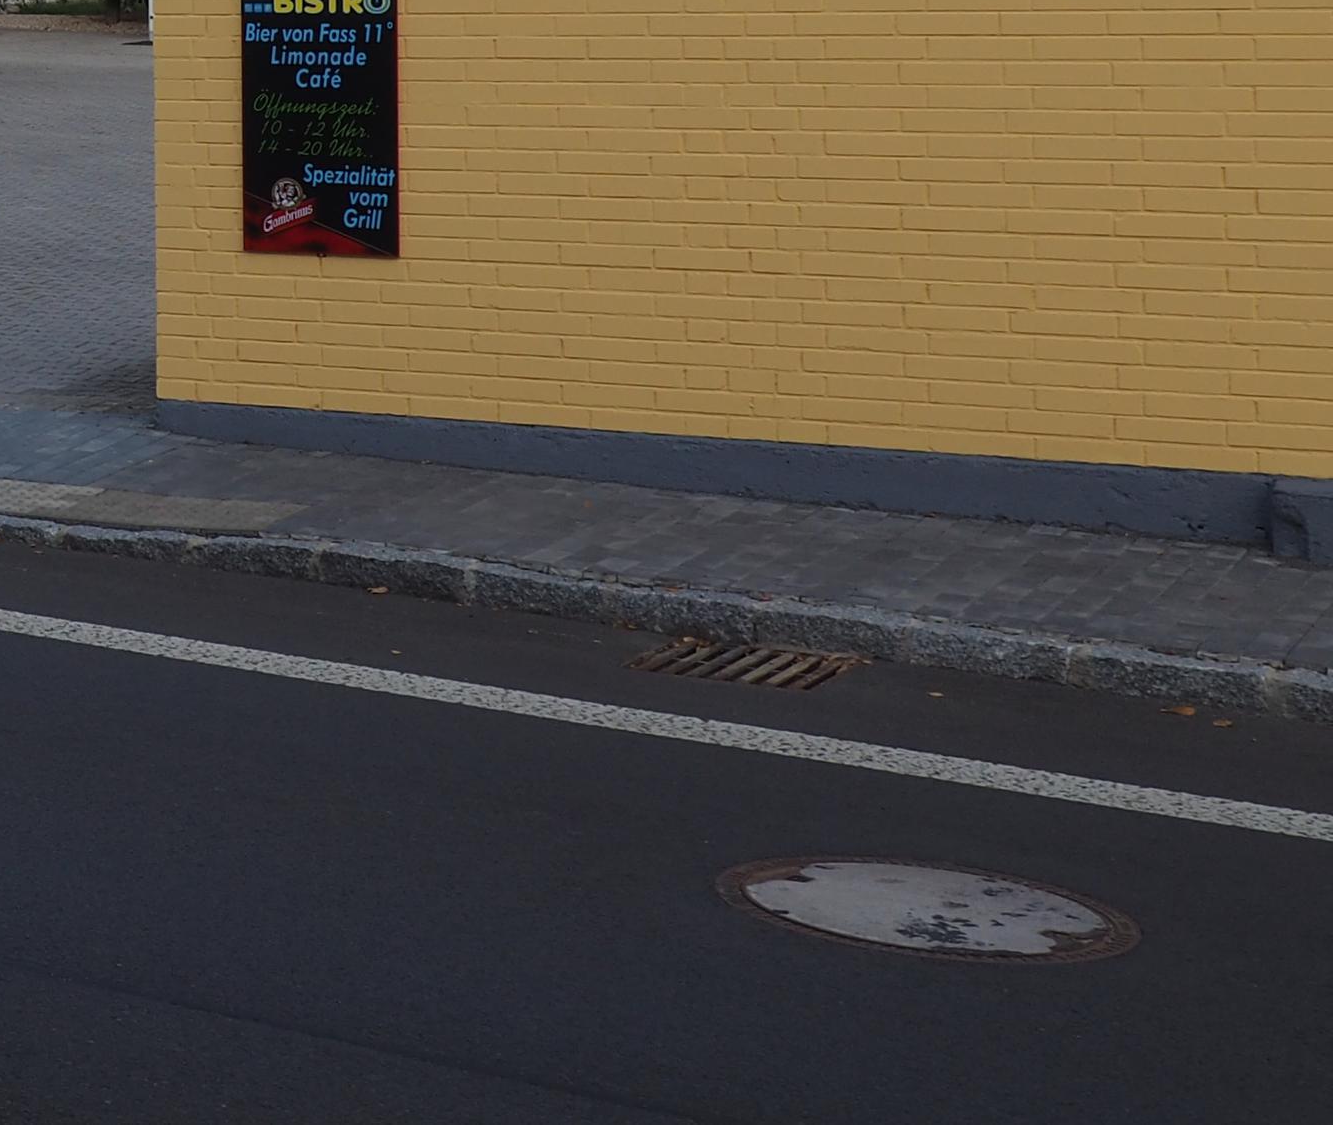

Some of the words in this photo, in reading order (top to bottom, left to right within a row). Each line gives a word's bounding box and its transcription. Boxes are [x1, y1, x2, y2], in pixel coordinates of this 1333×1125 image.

[245, 23, 278, 42] Bier
[280, 28, 314, 42] von
[319, 23, 357, 43] Fass
[271, 45, 367, 66] Limonade
[296, 68, 342, 88] Café
[253, 89, 380, 121] Öffnungszeit:
[261, 120, 282, 135] 10
[303, 121, 325, 136] 12
[257, 139, 279, 154] 14
[297, 141, 323, 155] 20
[303, 163, 396, 187] Spezialität
[349, 191, 389, 207] vom
[343, 208, 382, 230] Grill
